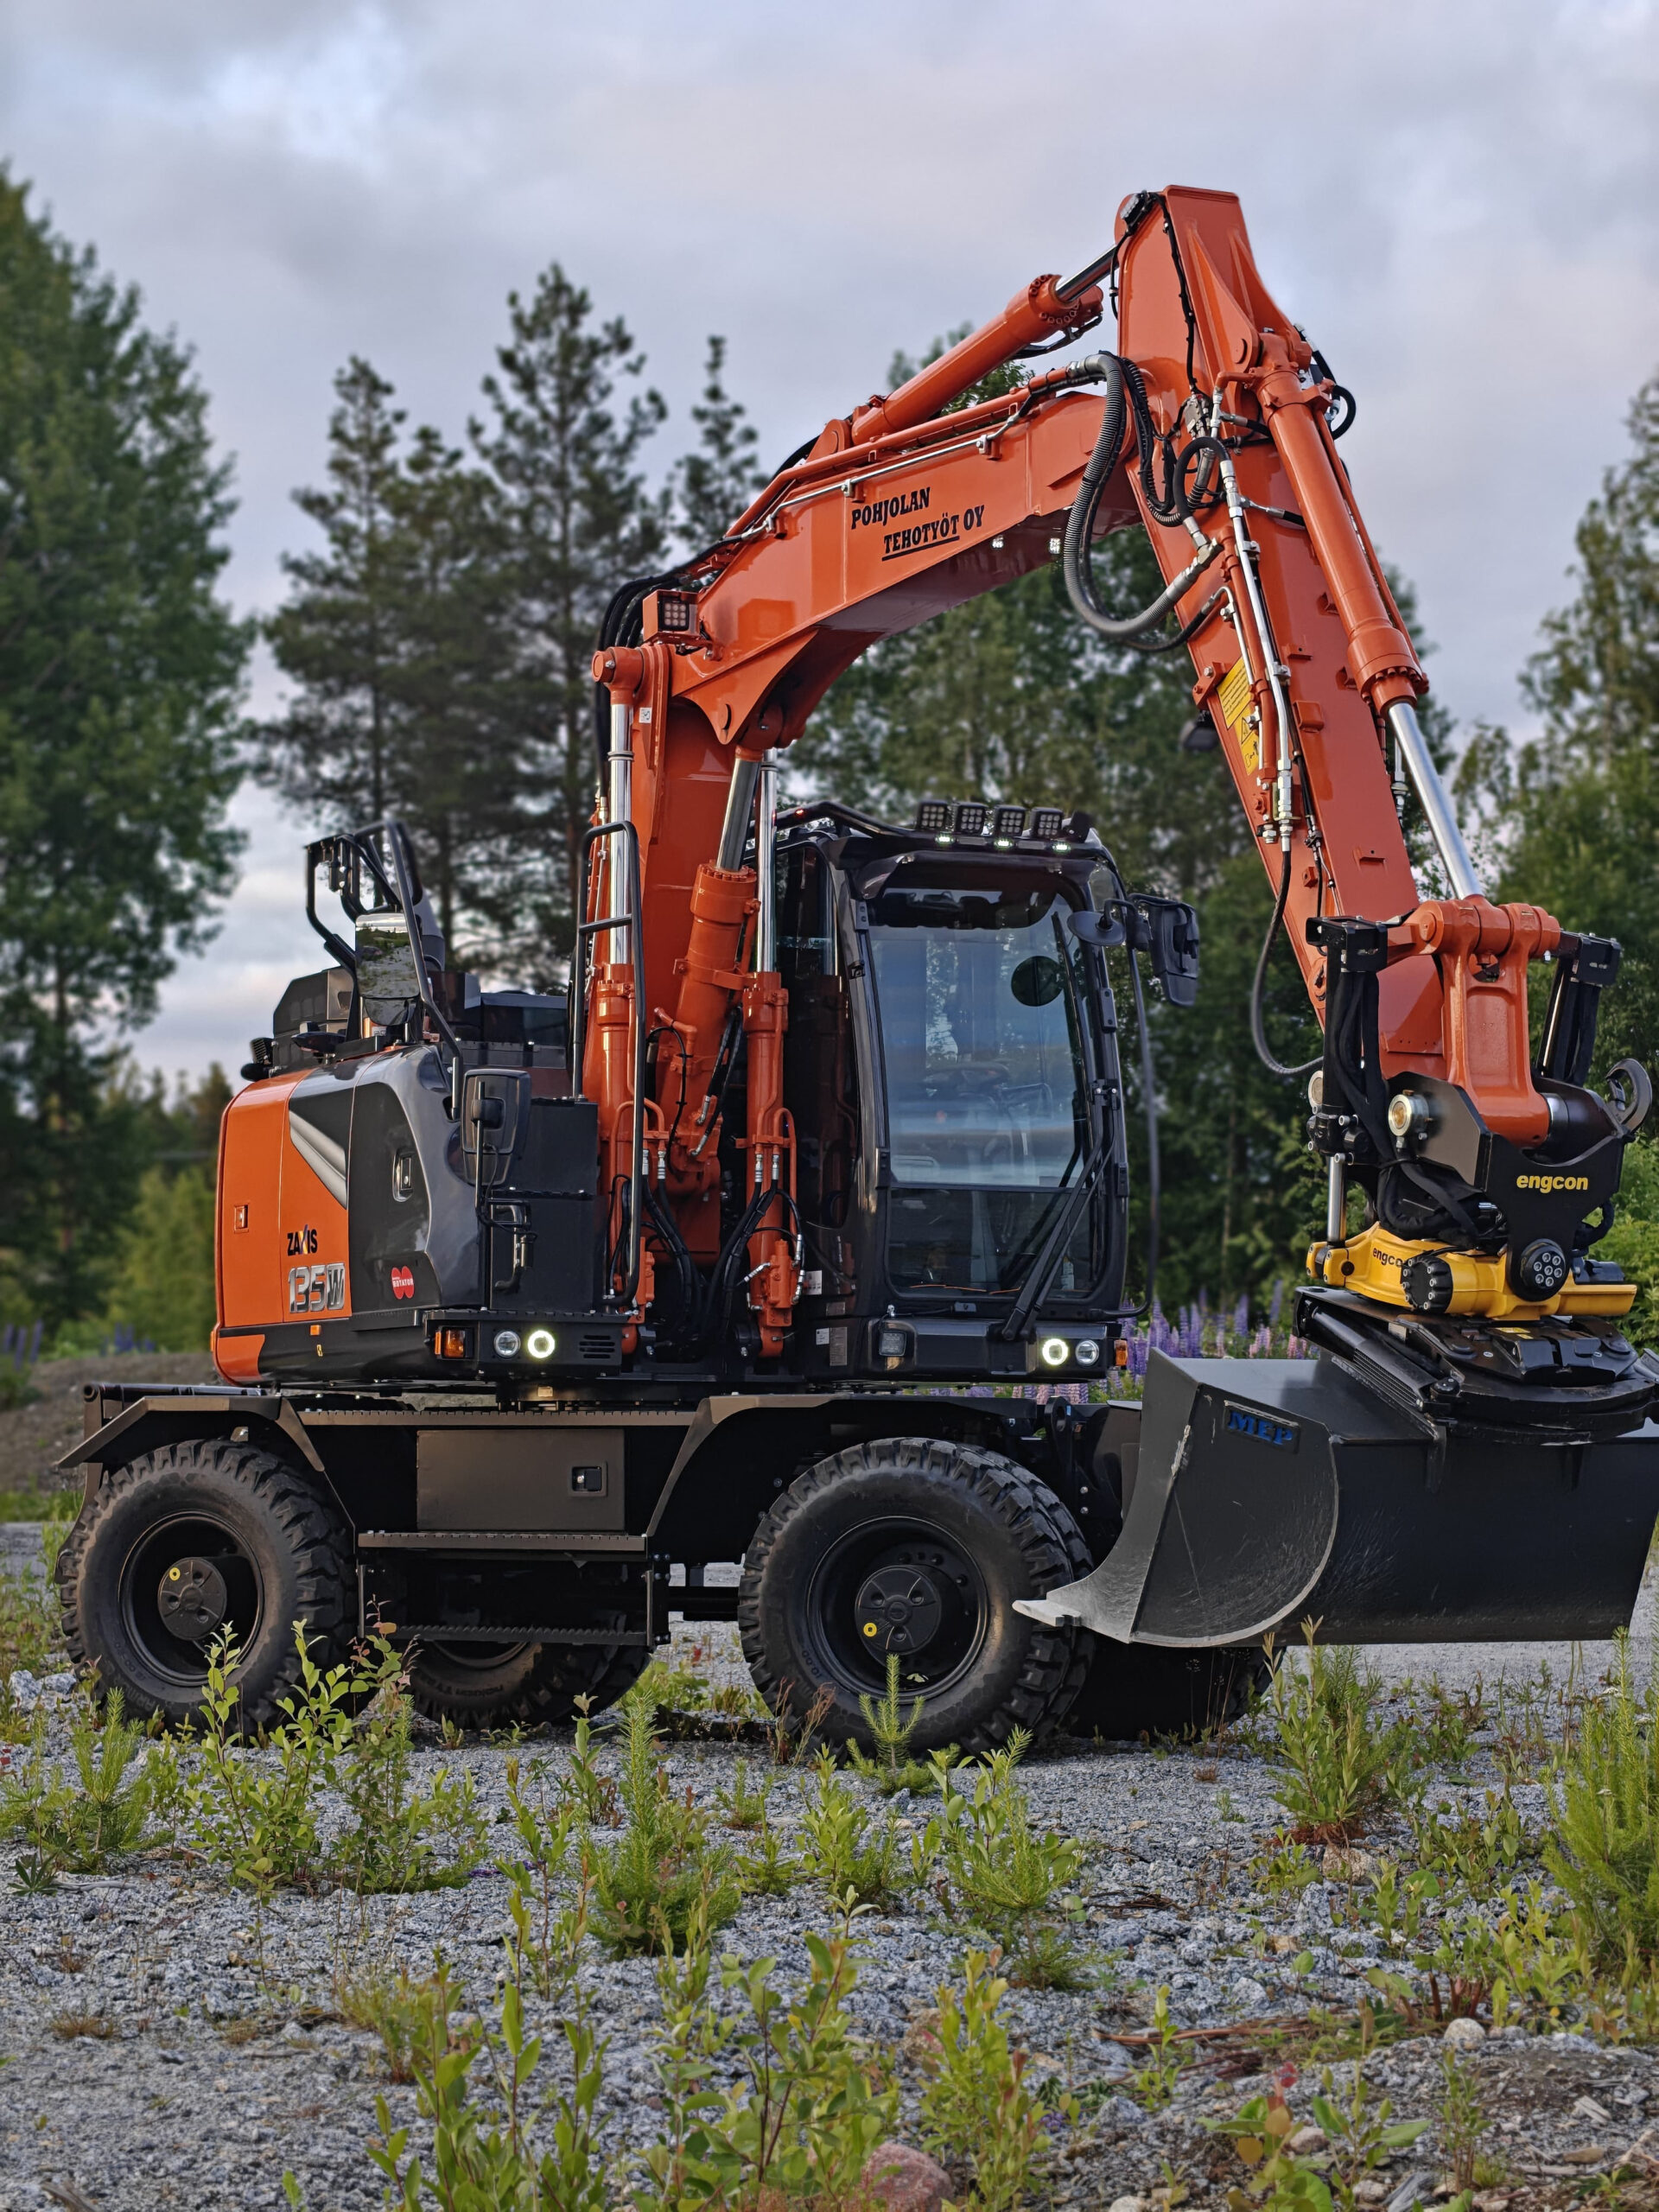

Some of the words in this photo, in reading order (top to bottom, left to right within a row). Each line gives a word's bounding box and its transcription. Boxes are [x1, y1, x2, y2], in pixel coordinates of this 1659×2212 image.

[851, 486, 931, 531] POHJOLAN
[883, 513, 960, 554] TEHOTYÖT
[963, 505, 985, 531] OY
[1516, 1175, 1589, 1193] engcon
[287, 1224, 318, 1256] ZAXIS
[1372, 1247, 1404, 1268] engco
[288, 1262, 346, 1313] 135W
[392, 1278, 414, 1287] ROTATOR
[1228, 1410, 1294, 1446] MEP
